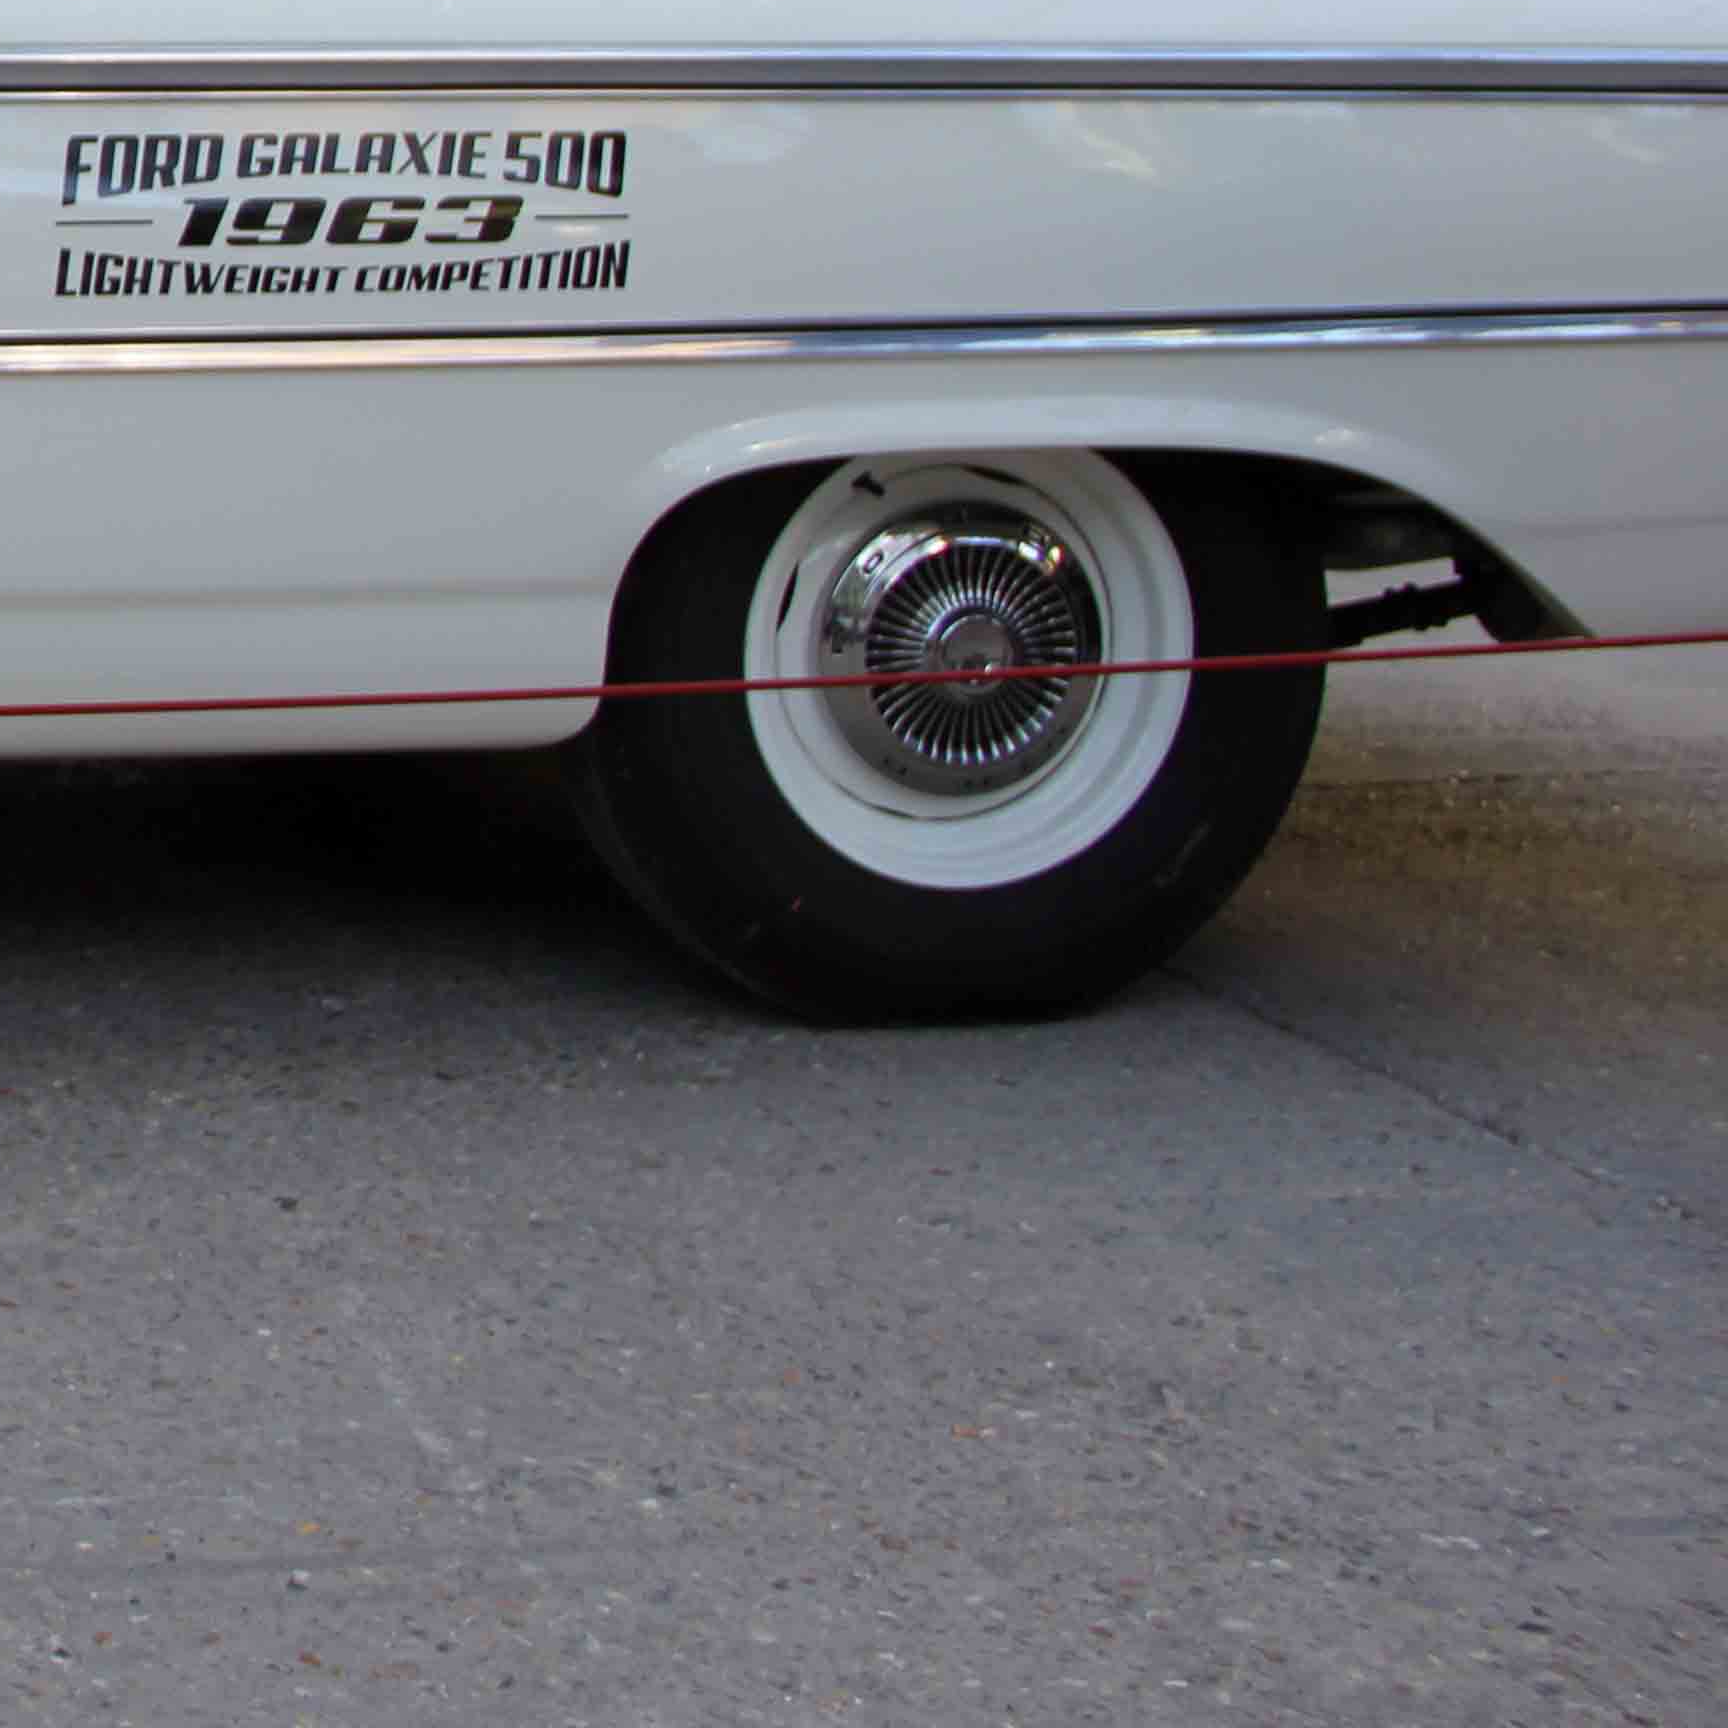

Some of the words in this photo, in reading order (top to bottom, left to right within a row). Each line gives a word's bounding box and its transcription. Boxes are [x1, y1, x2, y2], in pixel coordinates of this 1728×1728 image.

[61, 132, 225, 207] FORD
[235, 130, 493, 179] GALAXIE
[503, 129, 628, 198] 500
[176, 194, 525, 247] 1963
[54, 247, 351, 297] LIGHTWEIGHT
[353, 238, 631, 294] COMPETITION
